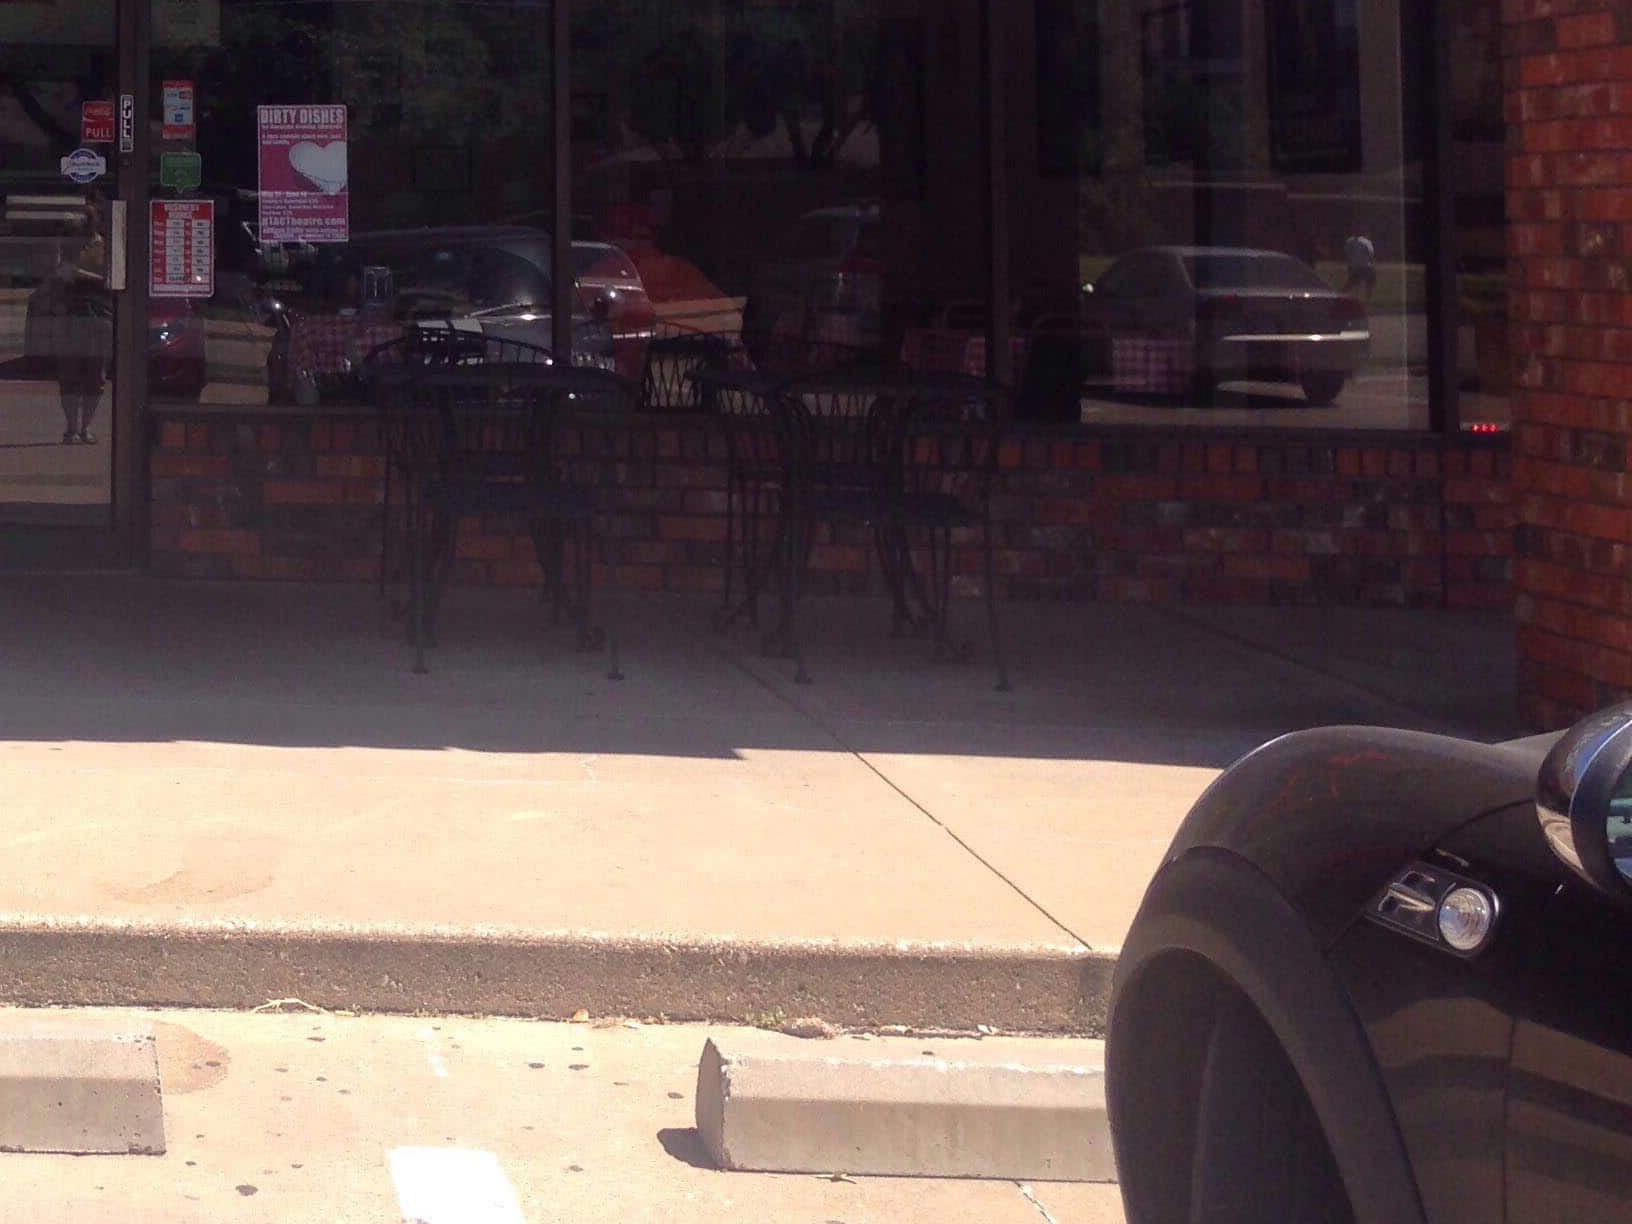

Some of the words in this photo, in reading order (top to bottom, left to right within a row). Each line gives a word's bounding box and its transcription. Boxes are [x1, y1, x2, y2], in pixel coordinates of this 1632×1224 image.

[123, 99, 132, 138] PULL
[260, 108, 297, 124] DIRTY
[299, 108, 345, 124] DISHES
[86, 127, 111, 138] PULL
